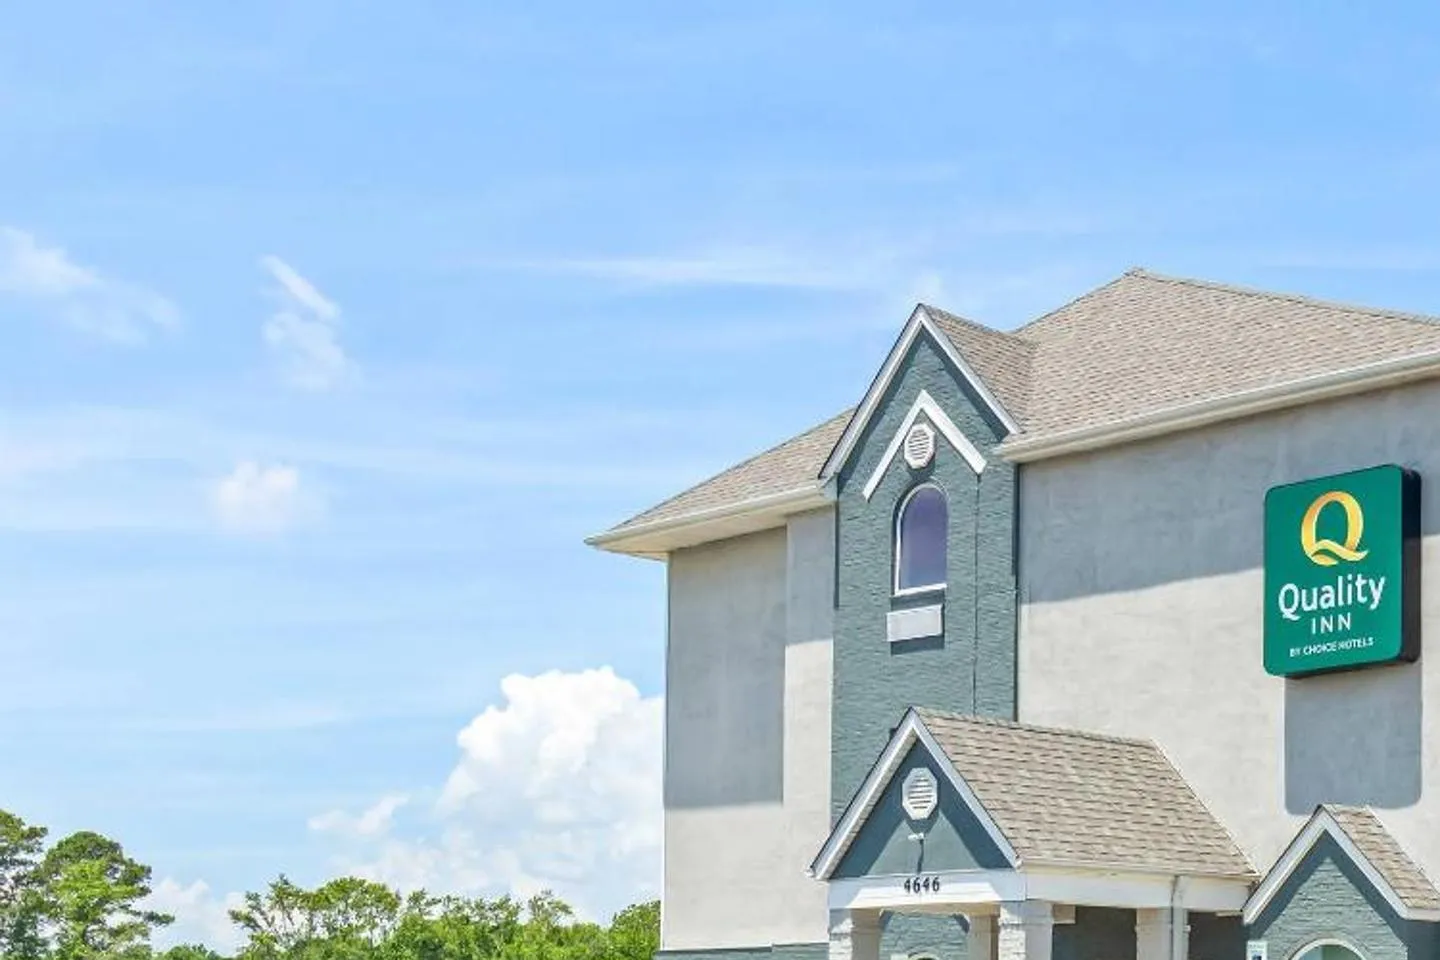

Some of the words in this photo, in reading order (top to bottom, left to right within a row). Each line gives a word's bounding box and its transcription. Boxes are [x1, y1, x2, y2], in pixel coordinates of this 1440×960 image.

[1301, 491, 1369, 566] Q
[1278, 573, 1386, 621] Quality
[1311, 612, 1351, 635] INN
[1303, 641, 1337, 656] CHOICE
[1338, 636, 1374, 650] HOTELS
[904, 876, 940, 894] 4646
